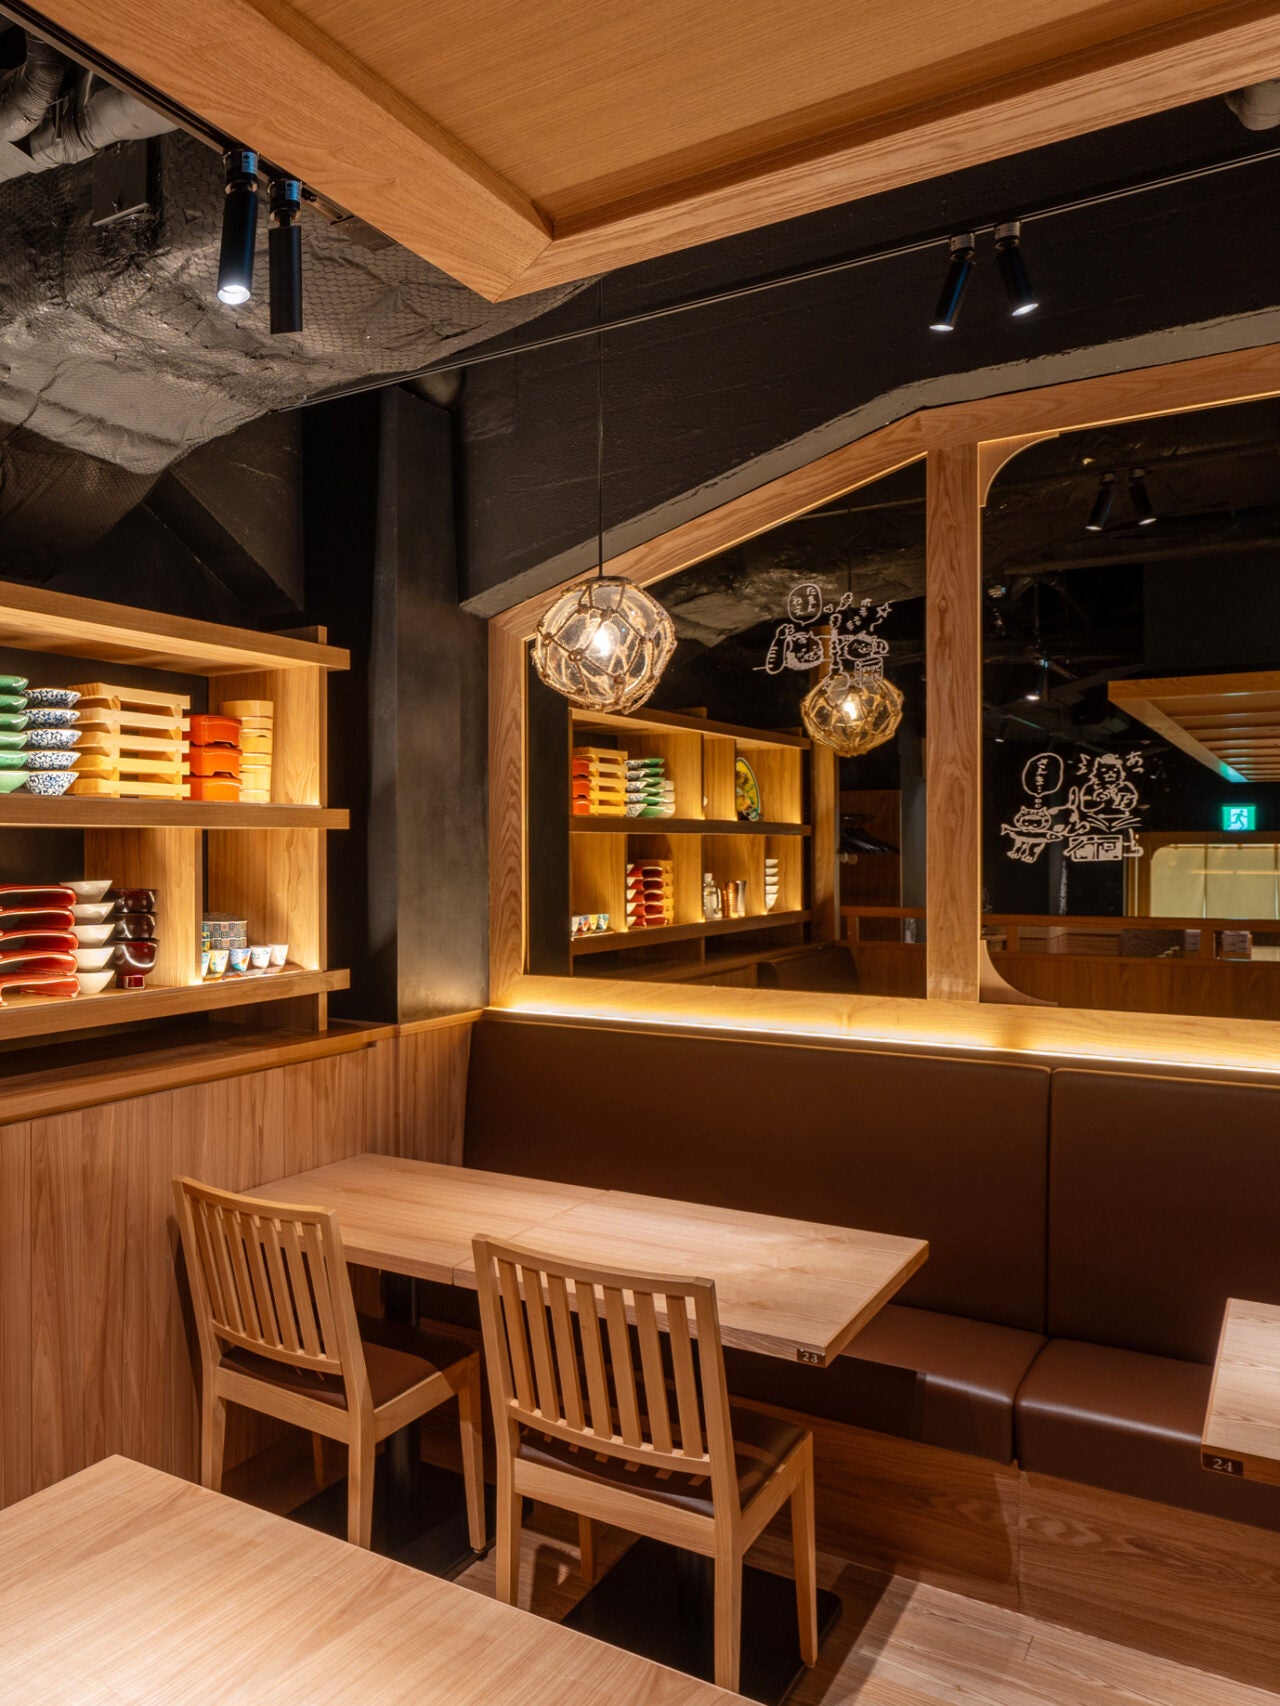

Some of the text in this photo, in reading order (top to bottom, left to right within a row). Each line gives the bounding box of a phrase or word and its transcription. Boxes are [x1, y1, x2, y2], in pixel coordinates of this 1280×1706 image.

[1124, 750, 1145, 774] あっ
[802, 1352, 818, 1363] 23
[1212, 1458, 1233, 1472] 24
